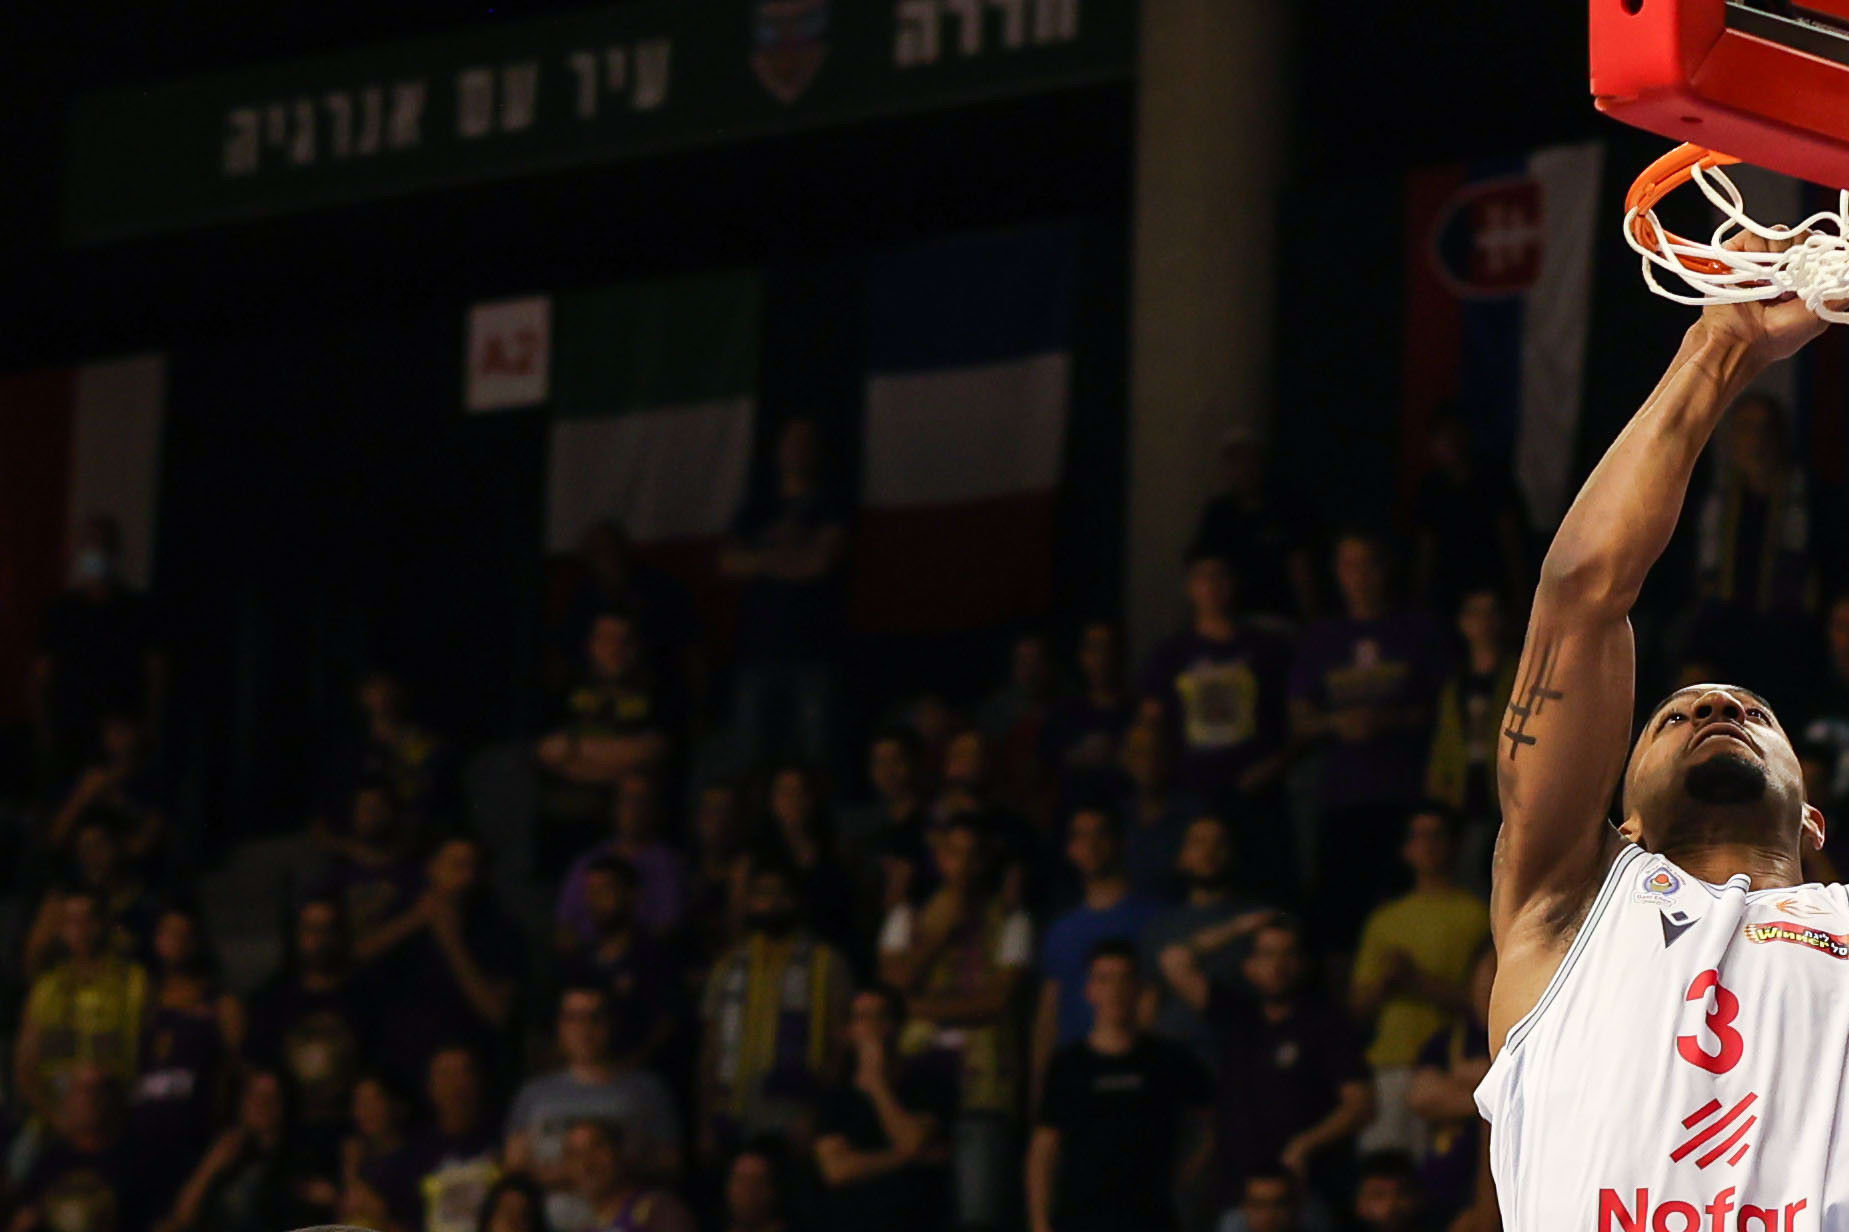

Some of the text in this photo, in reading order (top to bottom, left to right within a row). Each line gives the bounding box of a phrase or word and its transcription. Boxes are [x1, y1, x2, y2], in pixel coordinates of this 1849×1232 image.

[564, 34, 673, 121] עיר
[221, 76, 430, 178] אנרגיה
[1756, 925, 1830, 949] Winner
[1677, 969, 1744, 1075] 3
